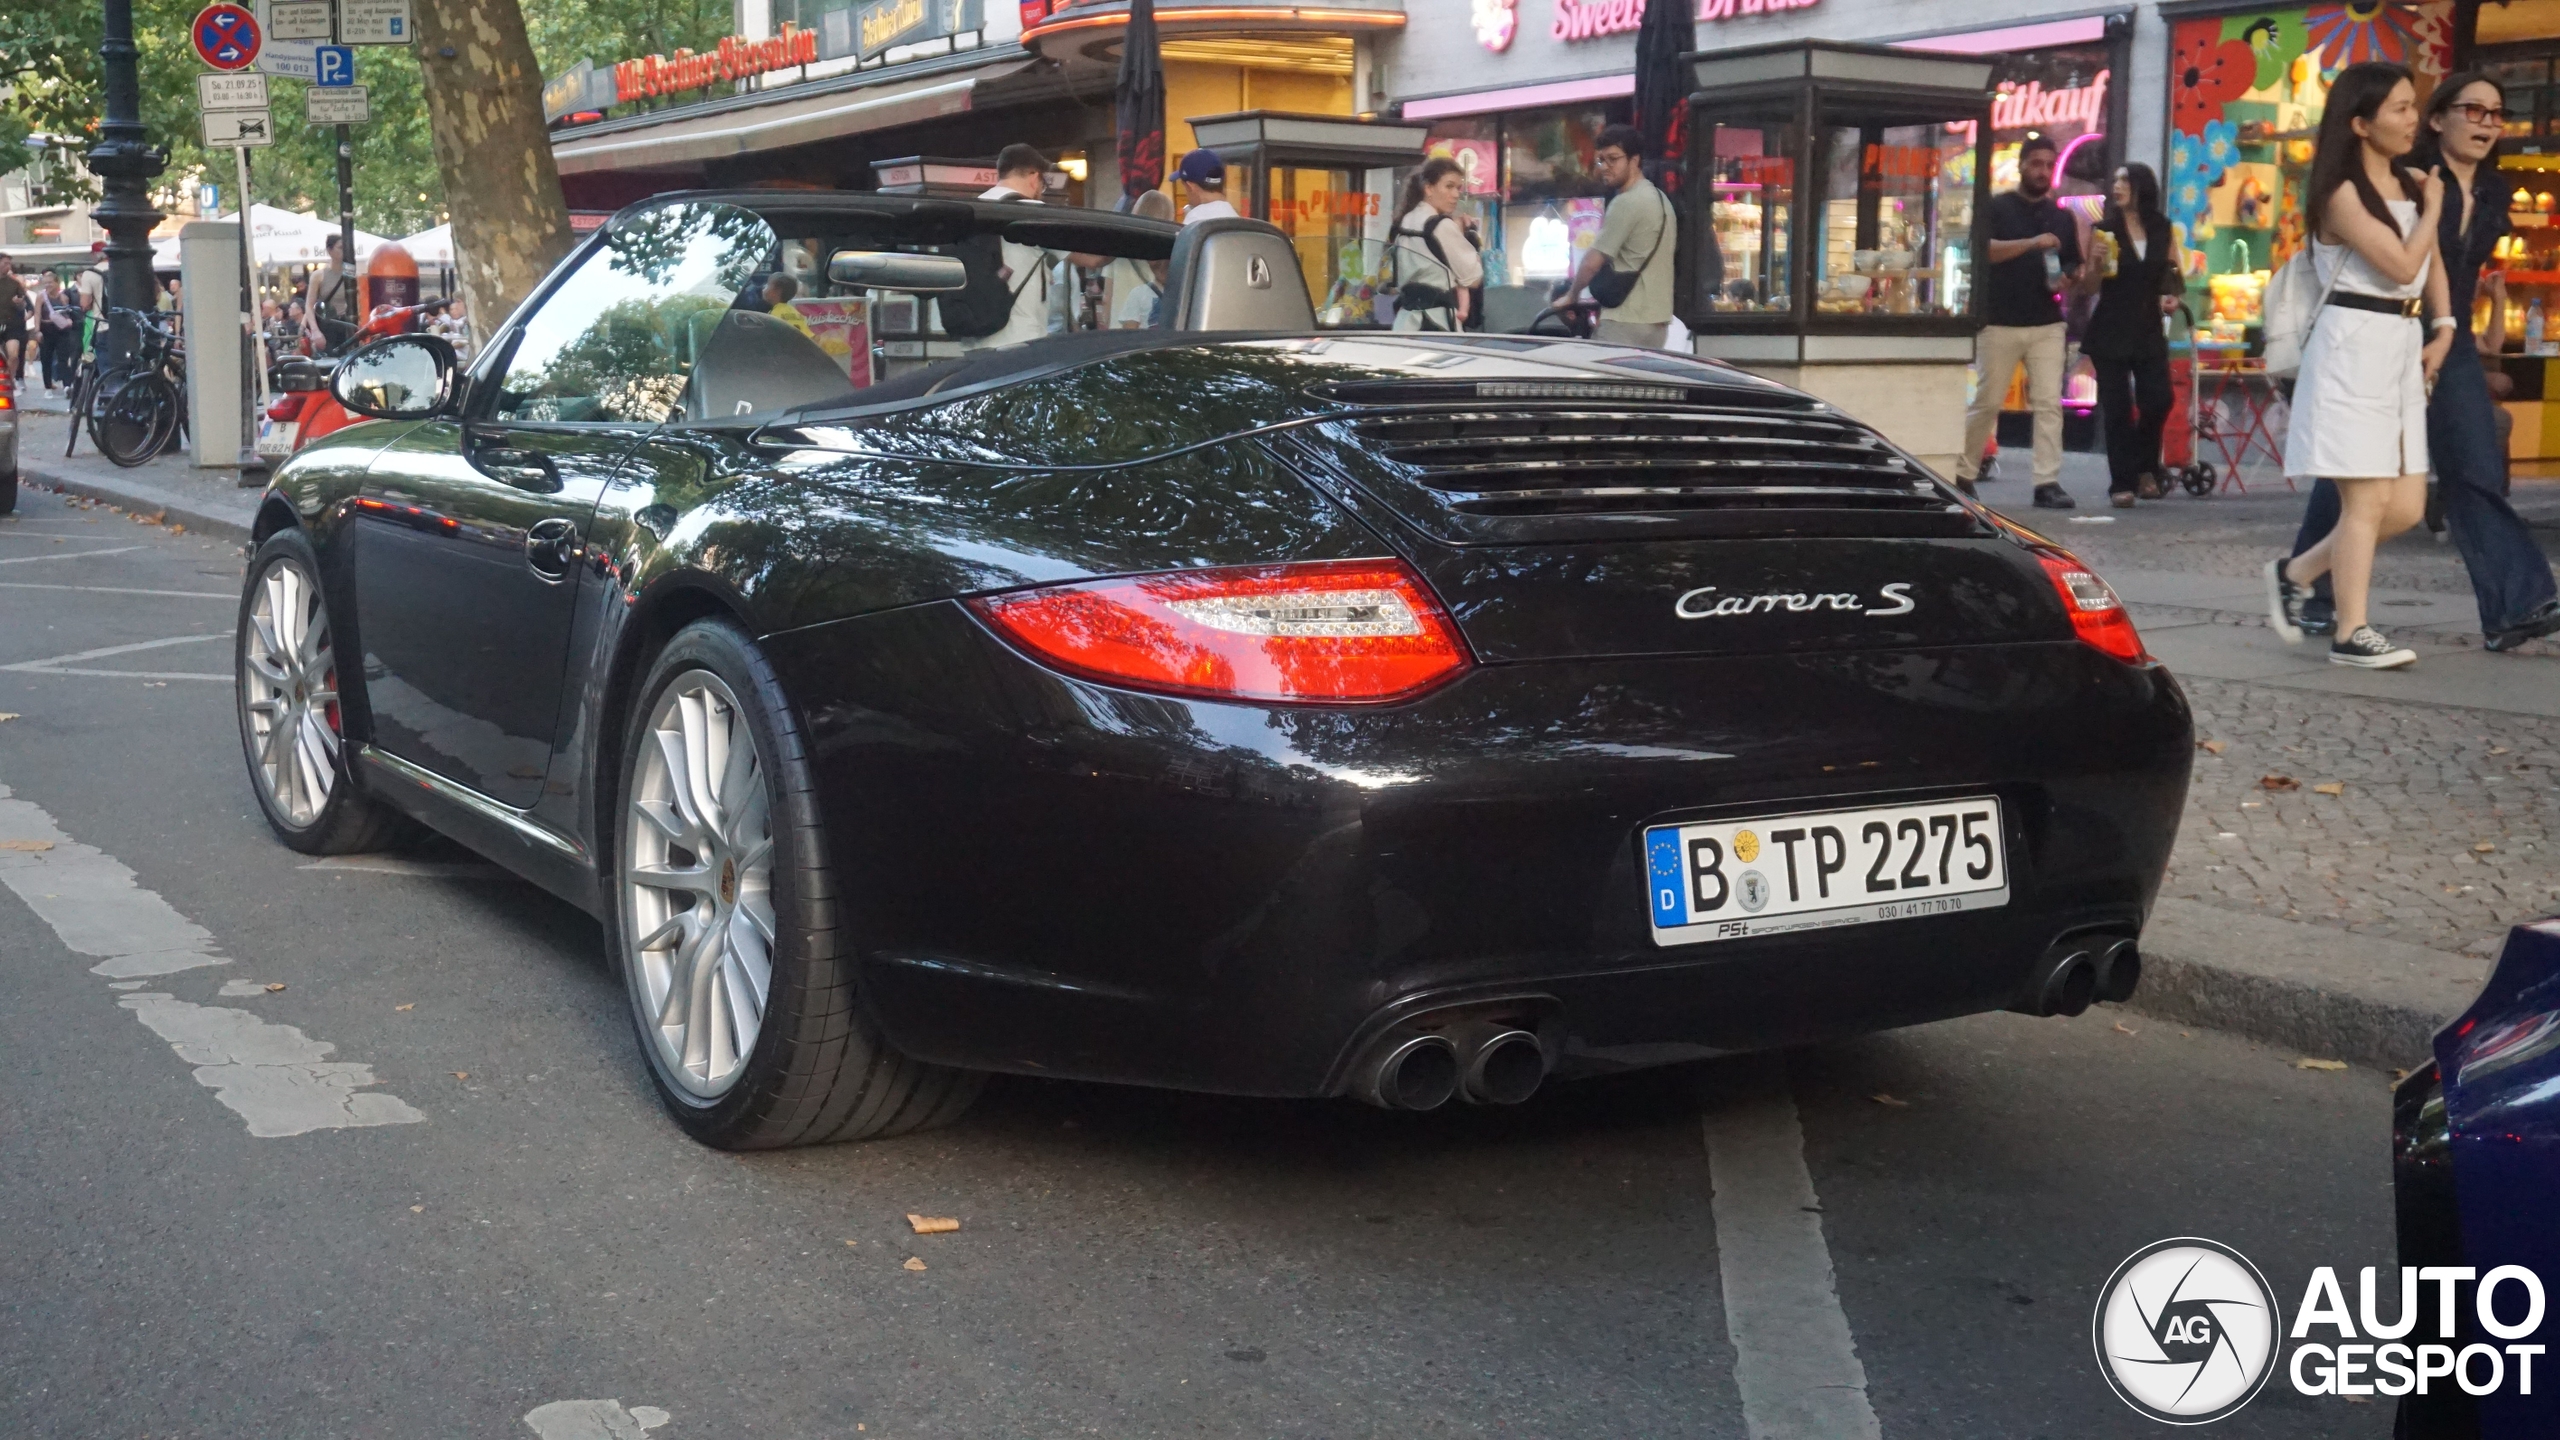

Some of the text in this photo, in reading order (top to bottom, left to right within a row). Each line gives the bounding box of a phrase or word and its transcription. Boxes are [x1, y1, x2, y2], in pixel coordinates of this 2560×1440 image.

[265, 52, 316, 62] Handyparkzon
[276, 62, 291, 71] 100
[321, 50, 342, 83] P
[1945, 68, 2111, 148] ätkauf
[974, 171, 998, 183] AST
[201, 187, 213, 207] U
[280, 423, 287, 433] B
[1675, 582, 1916, 620] Carrera S
[1687, 810, 1995, 914] B TP 2275
[1660, 888, 1675, 912] D
[1878, 905, 1898, 919] 030
[1906, 903, 1918, 915] 41
[1920, 901, 1933, 914] 77
[1935, 899, 1948, 912] 70
[1949, 897, 1962, 910] 70
[1718, 922, 1750, 938] PSt
